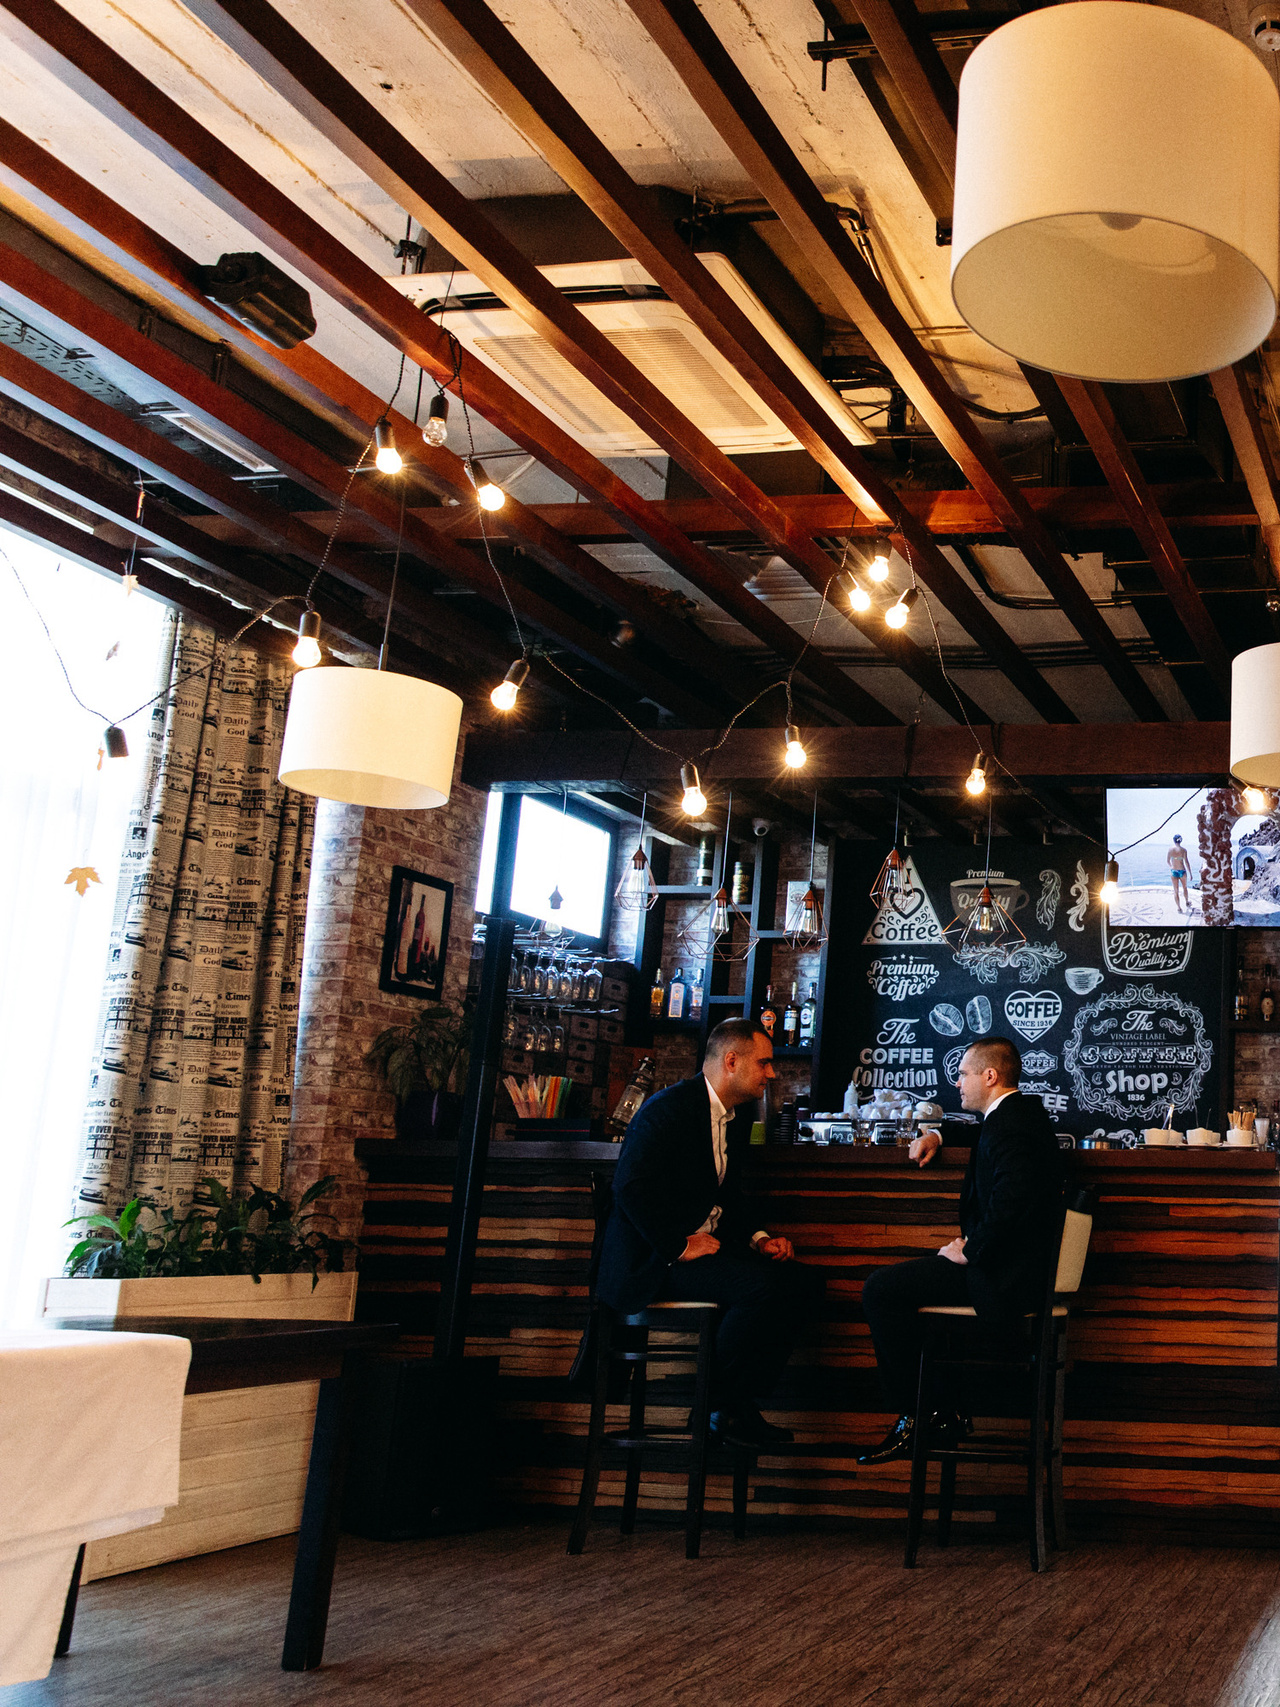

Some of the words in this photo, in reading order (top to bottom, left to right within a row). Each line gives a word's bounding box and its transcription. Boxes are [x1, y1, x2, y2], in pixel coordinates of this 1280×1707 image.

[224, 716, 249, 725] Daily
[227, 728, 246, 736] God
[215, 840, 234, 849] God
[237, 877, 261, 886] Times
[966, 869, 1005, 878] Premium
[871, 922, 940, 941] Coffee
[1107, 932, 1189, 957] Premium
[203, 957, 220, 965] God
[870, 959, 938, 977] Premium
[1125, 952, 1168, 971] Quality
[225, 991, 251, 1000] Times
[876, 977, 926, 1001] Coffee
[1006, 1001, 1061, 1018] COFFEE
[1121, 1010, 1156, 1032] The
[876, 1018, 920, 1045] The
[860, 1047, 934, 1065] COFFEE
[1079, 1045, 1197, 1065] COFFEE
[851, 1065, 939, 1089] Collection
[1105, 1069, 1169, 1094] Shop
[1127, 1093, 1146, 1101] 1836
